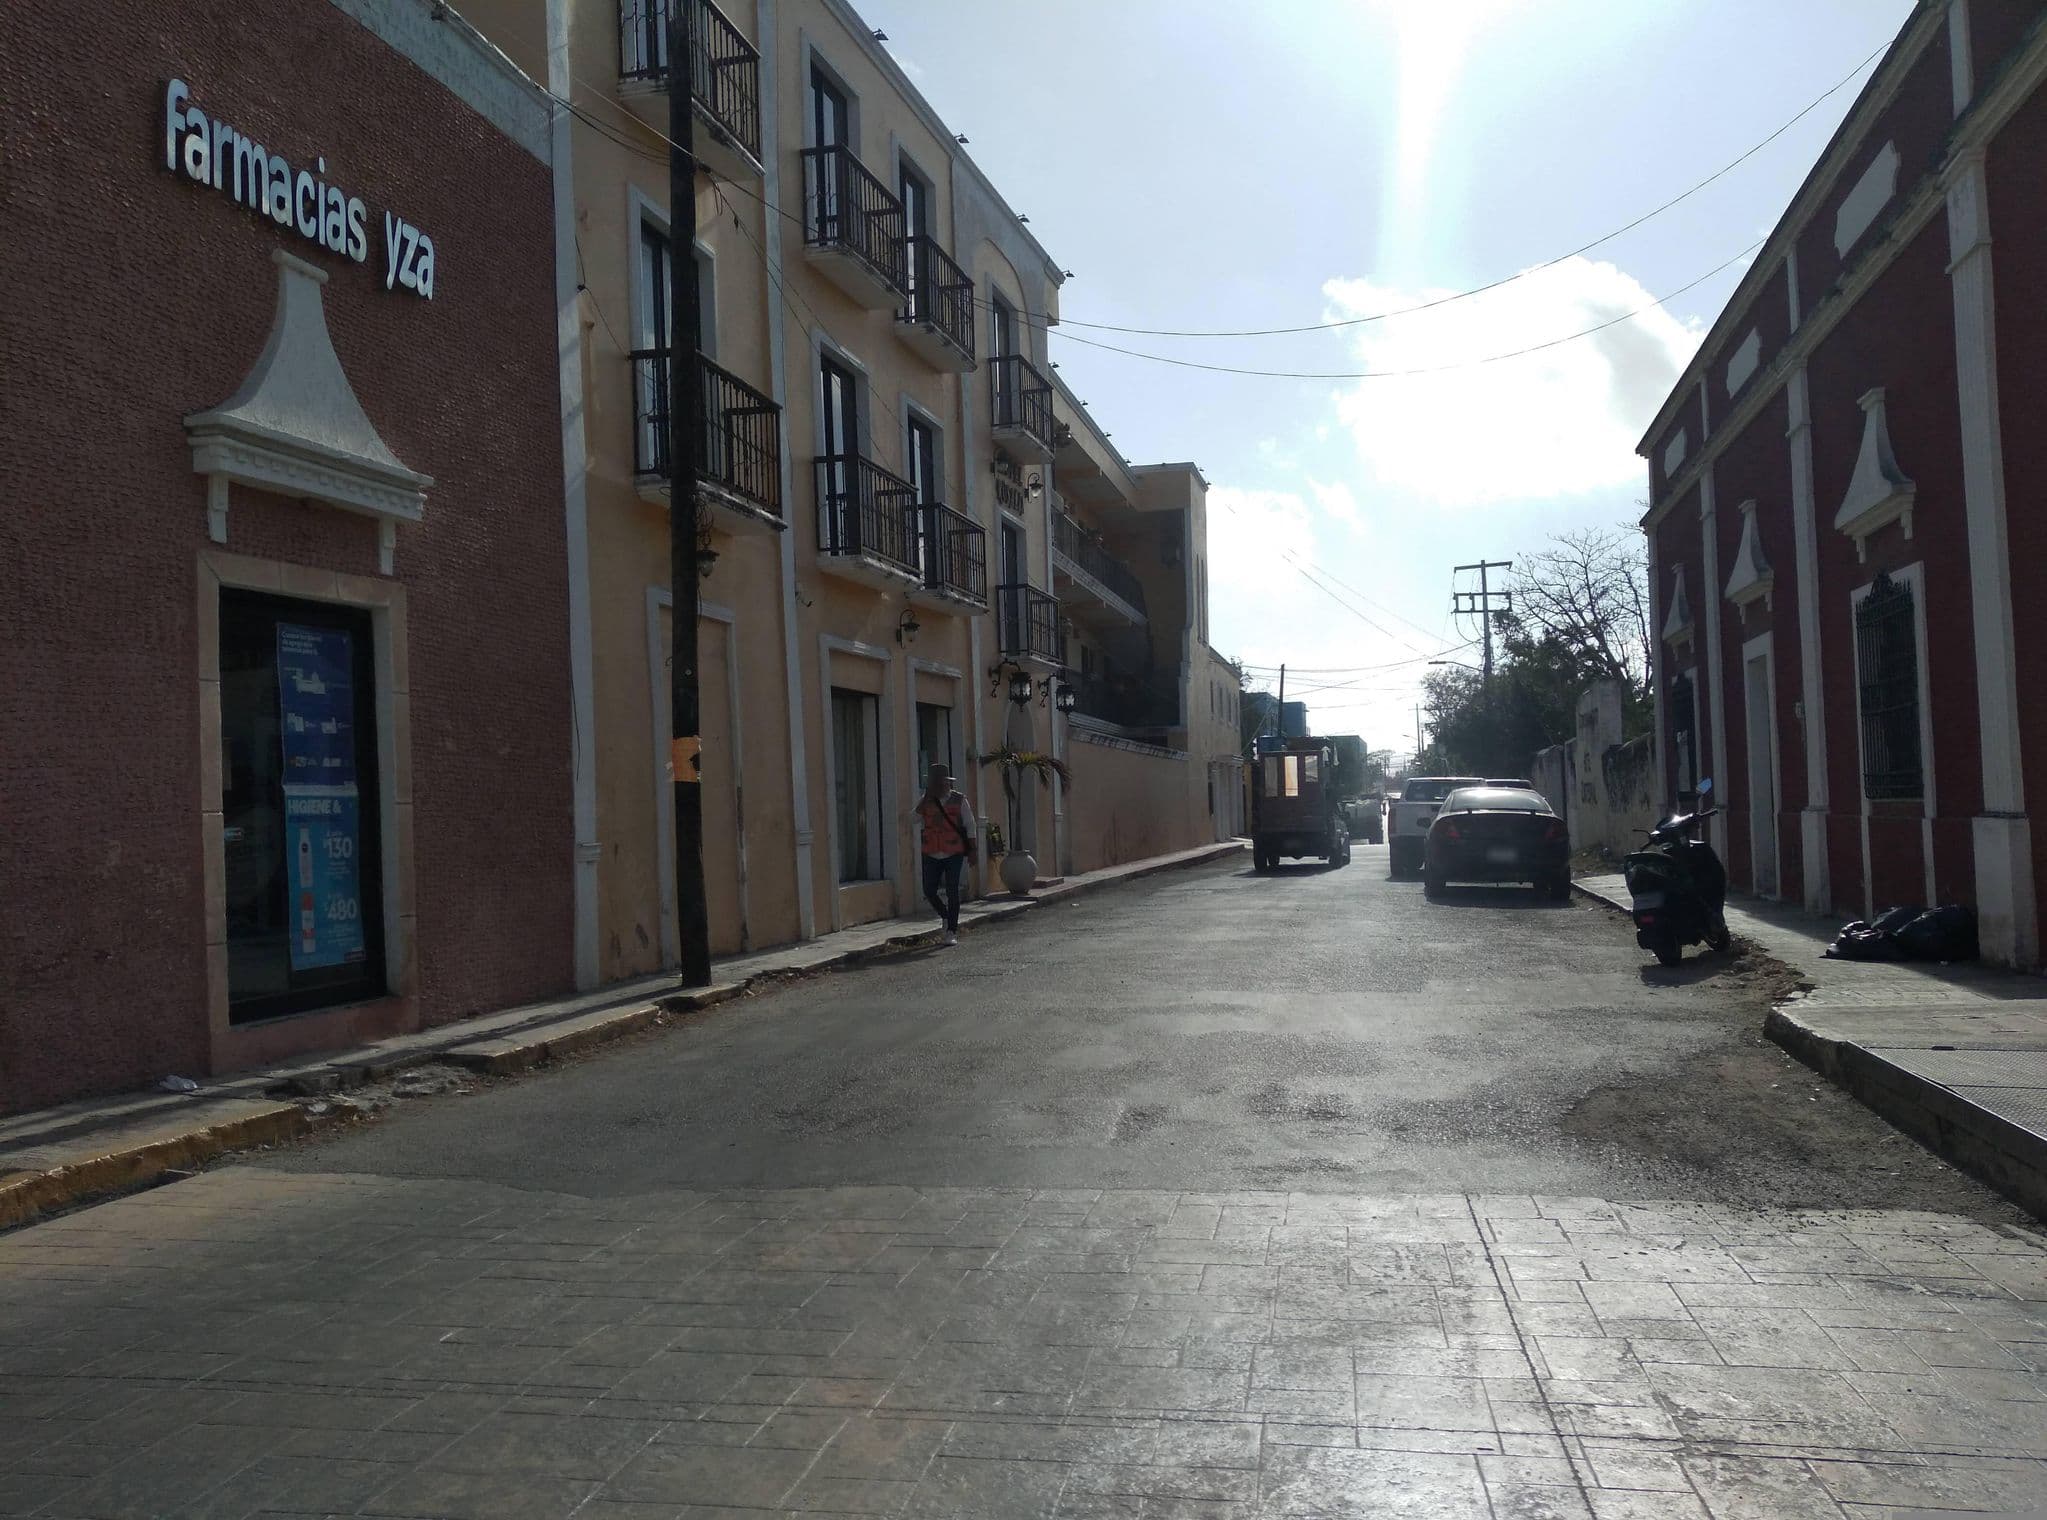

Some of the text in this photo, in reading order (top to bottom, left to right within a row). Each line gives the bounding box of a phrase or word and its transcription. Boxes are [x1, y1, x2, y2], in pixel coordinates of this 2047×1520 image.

[166, 78, 435, 300] farmacias yza
[287, 799, 331, 816] HIGIENE
